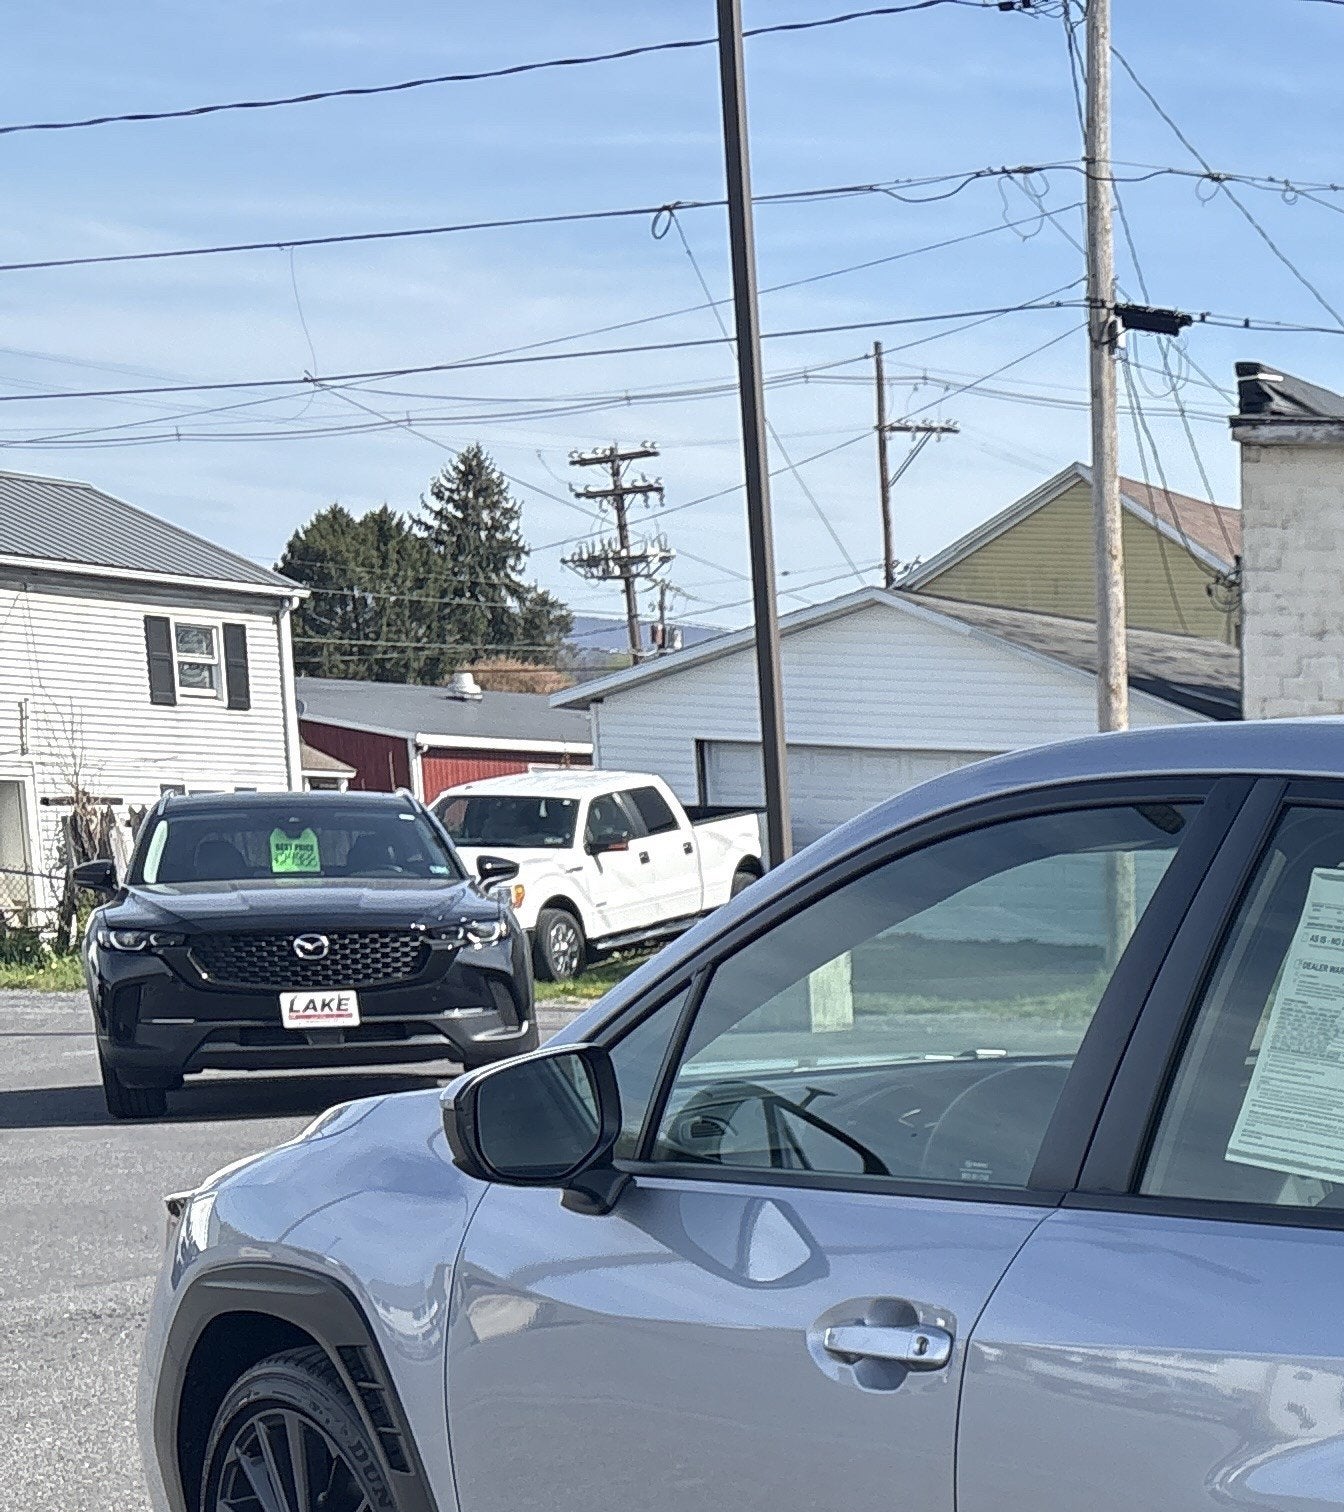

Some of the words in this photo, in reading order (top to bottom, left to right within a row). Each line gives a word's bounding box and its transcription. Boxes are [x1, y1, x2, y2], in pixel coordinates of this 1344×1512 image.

[1331, 937, 1341, 946] NO
[1302, 961, 1329, 973] DEALER
[288, 994, 351, 1013] LAKE
